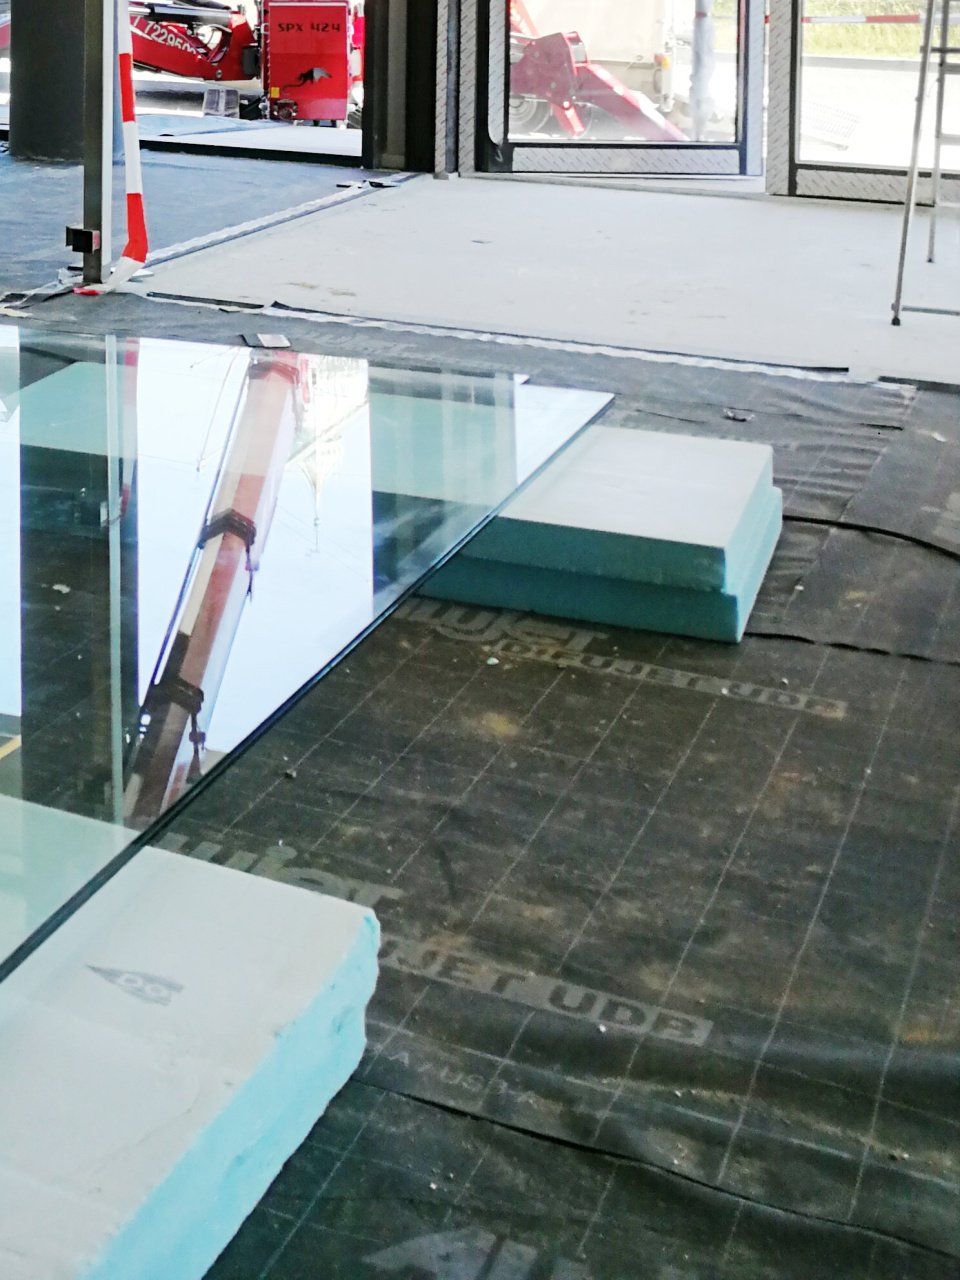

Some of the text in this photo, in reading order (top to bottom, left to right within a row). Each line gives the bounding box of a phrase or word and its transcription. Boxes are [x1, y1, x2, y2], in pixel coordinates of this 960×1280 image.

[278, 22, 341, 32] SPX 424
[549, 983, 701, 1041] UDB
